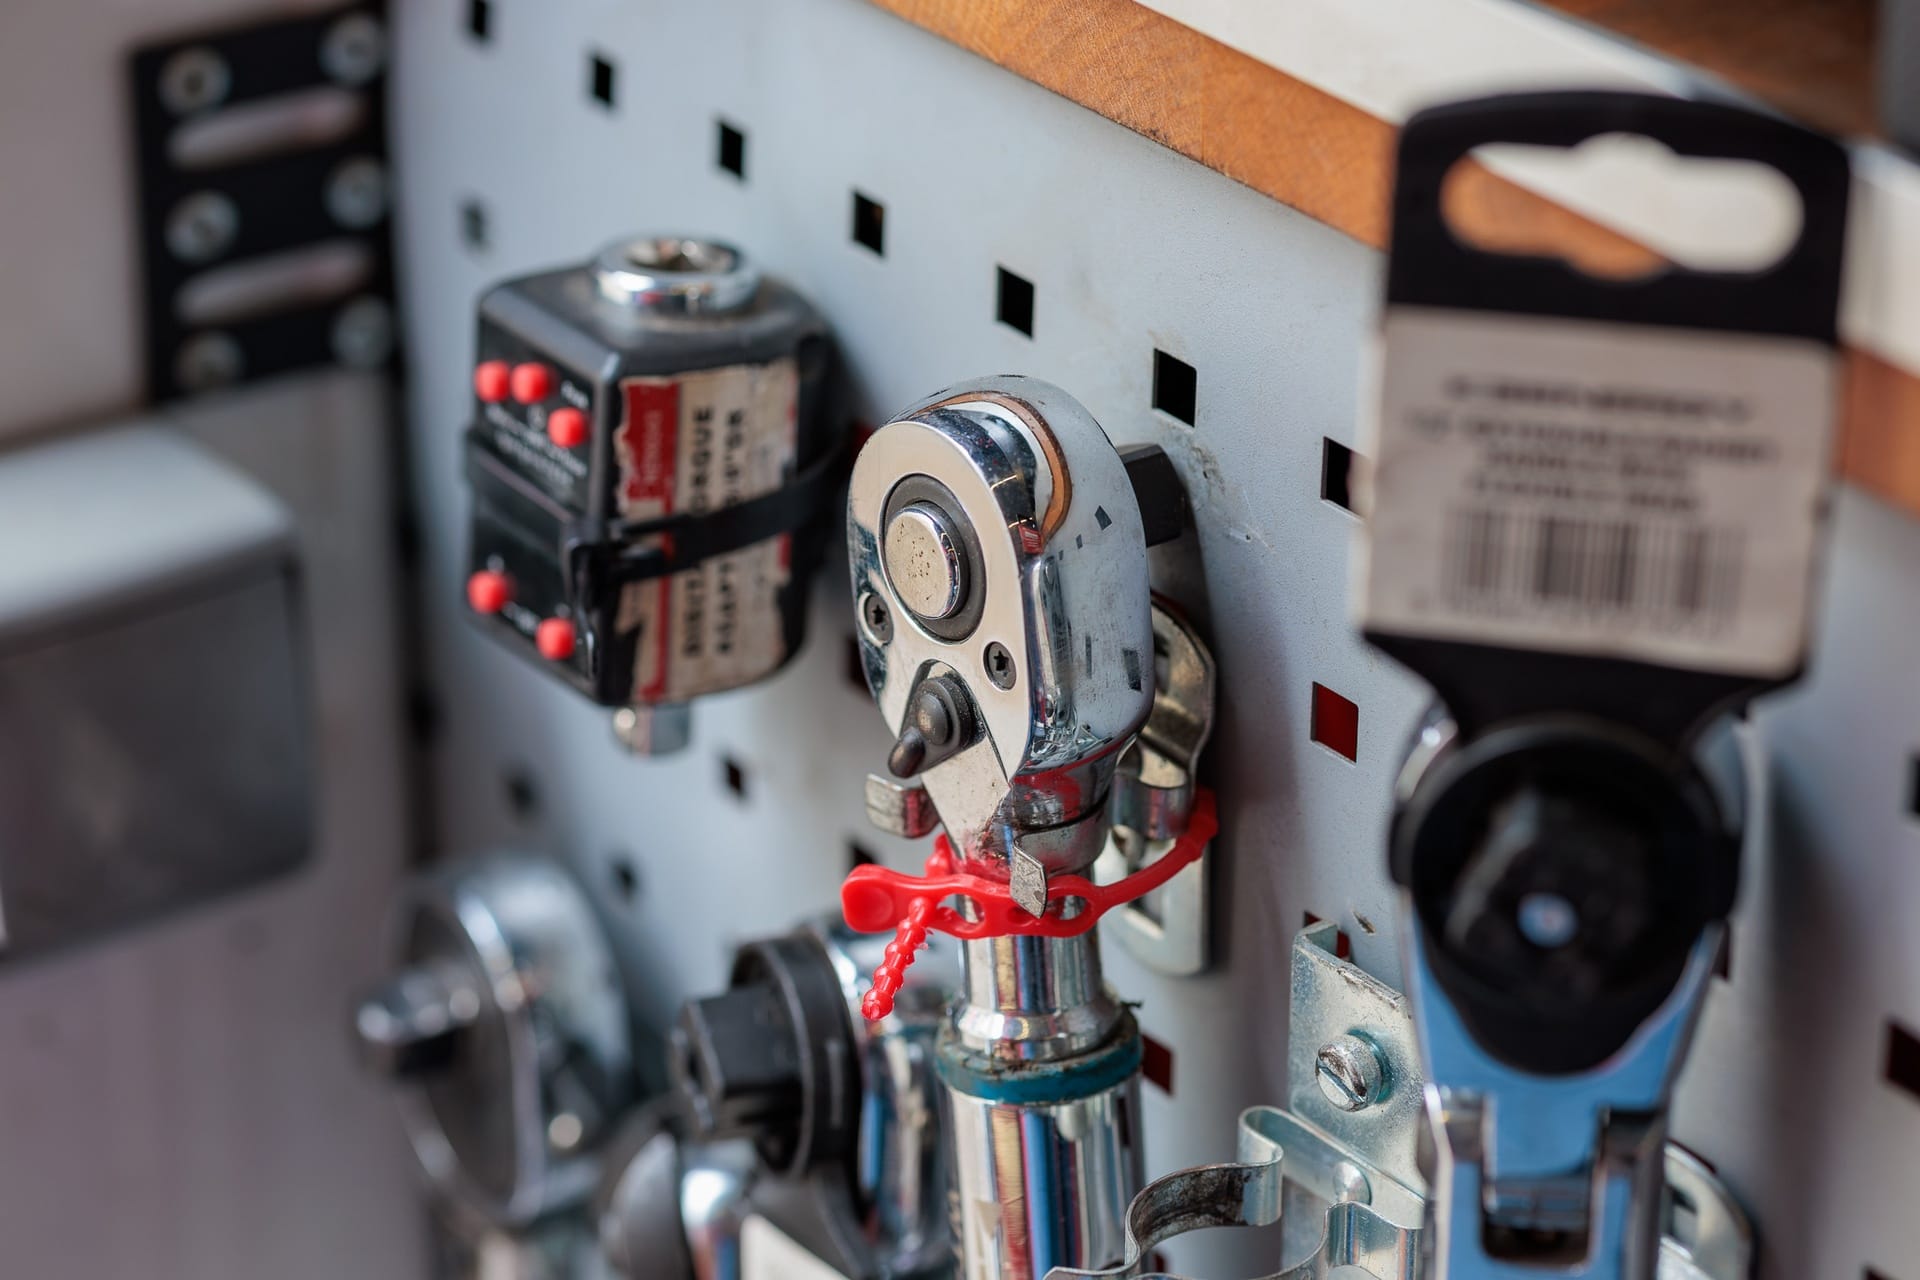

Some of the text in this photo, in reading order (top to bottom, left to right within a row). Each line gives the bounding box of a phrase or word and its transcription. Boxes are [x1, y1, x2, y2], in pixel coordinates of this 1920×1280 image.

[680, 406, 713, 658] DIGIT ORQUE
[713, 562, 736, 655] ADAPT
